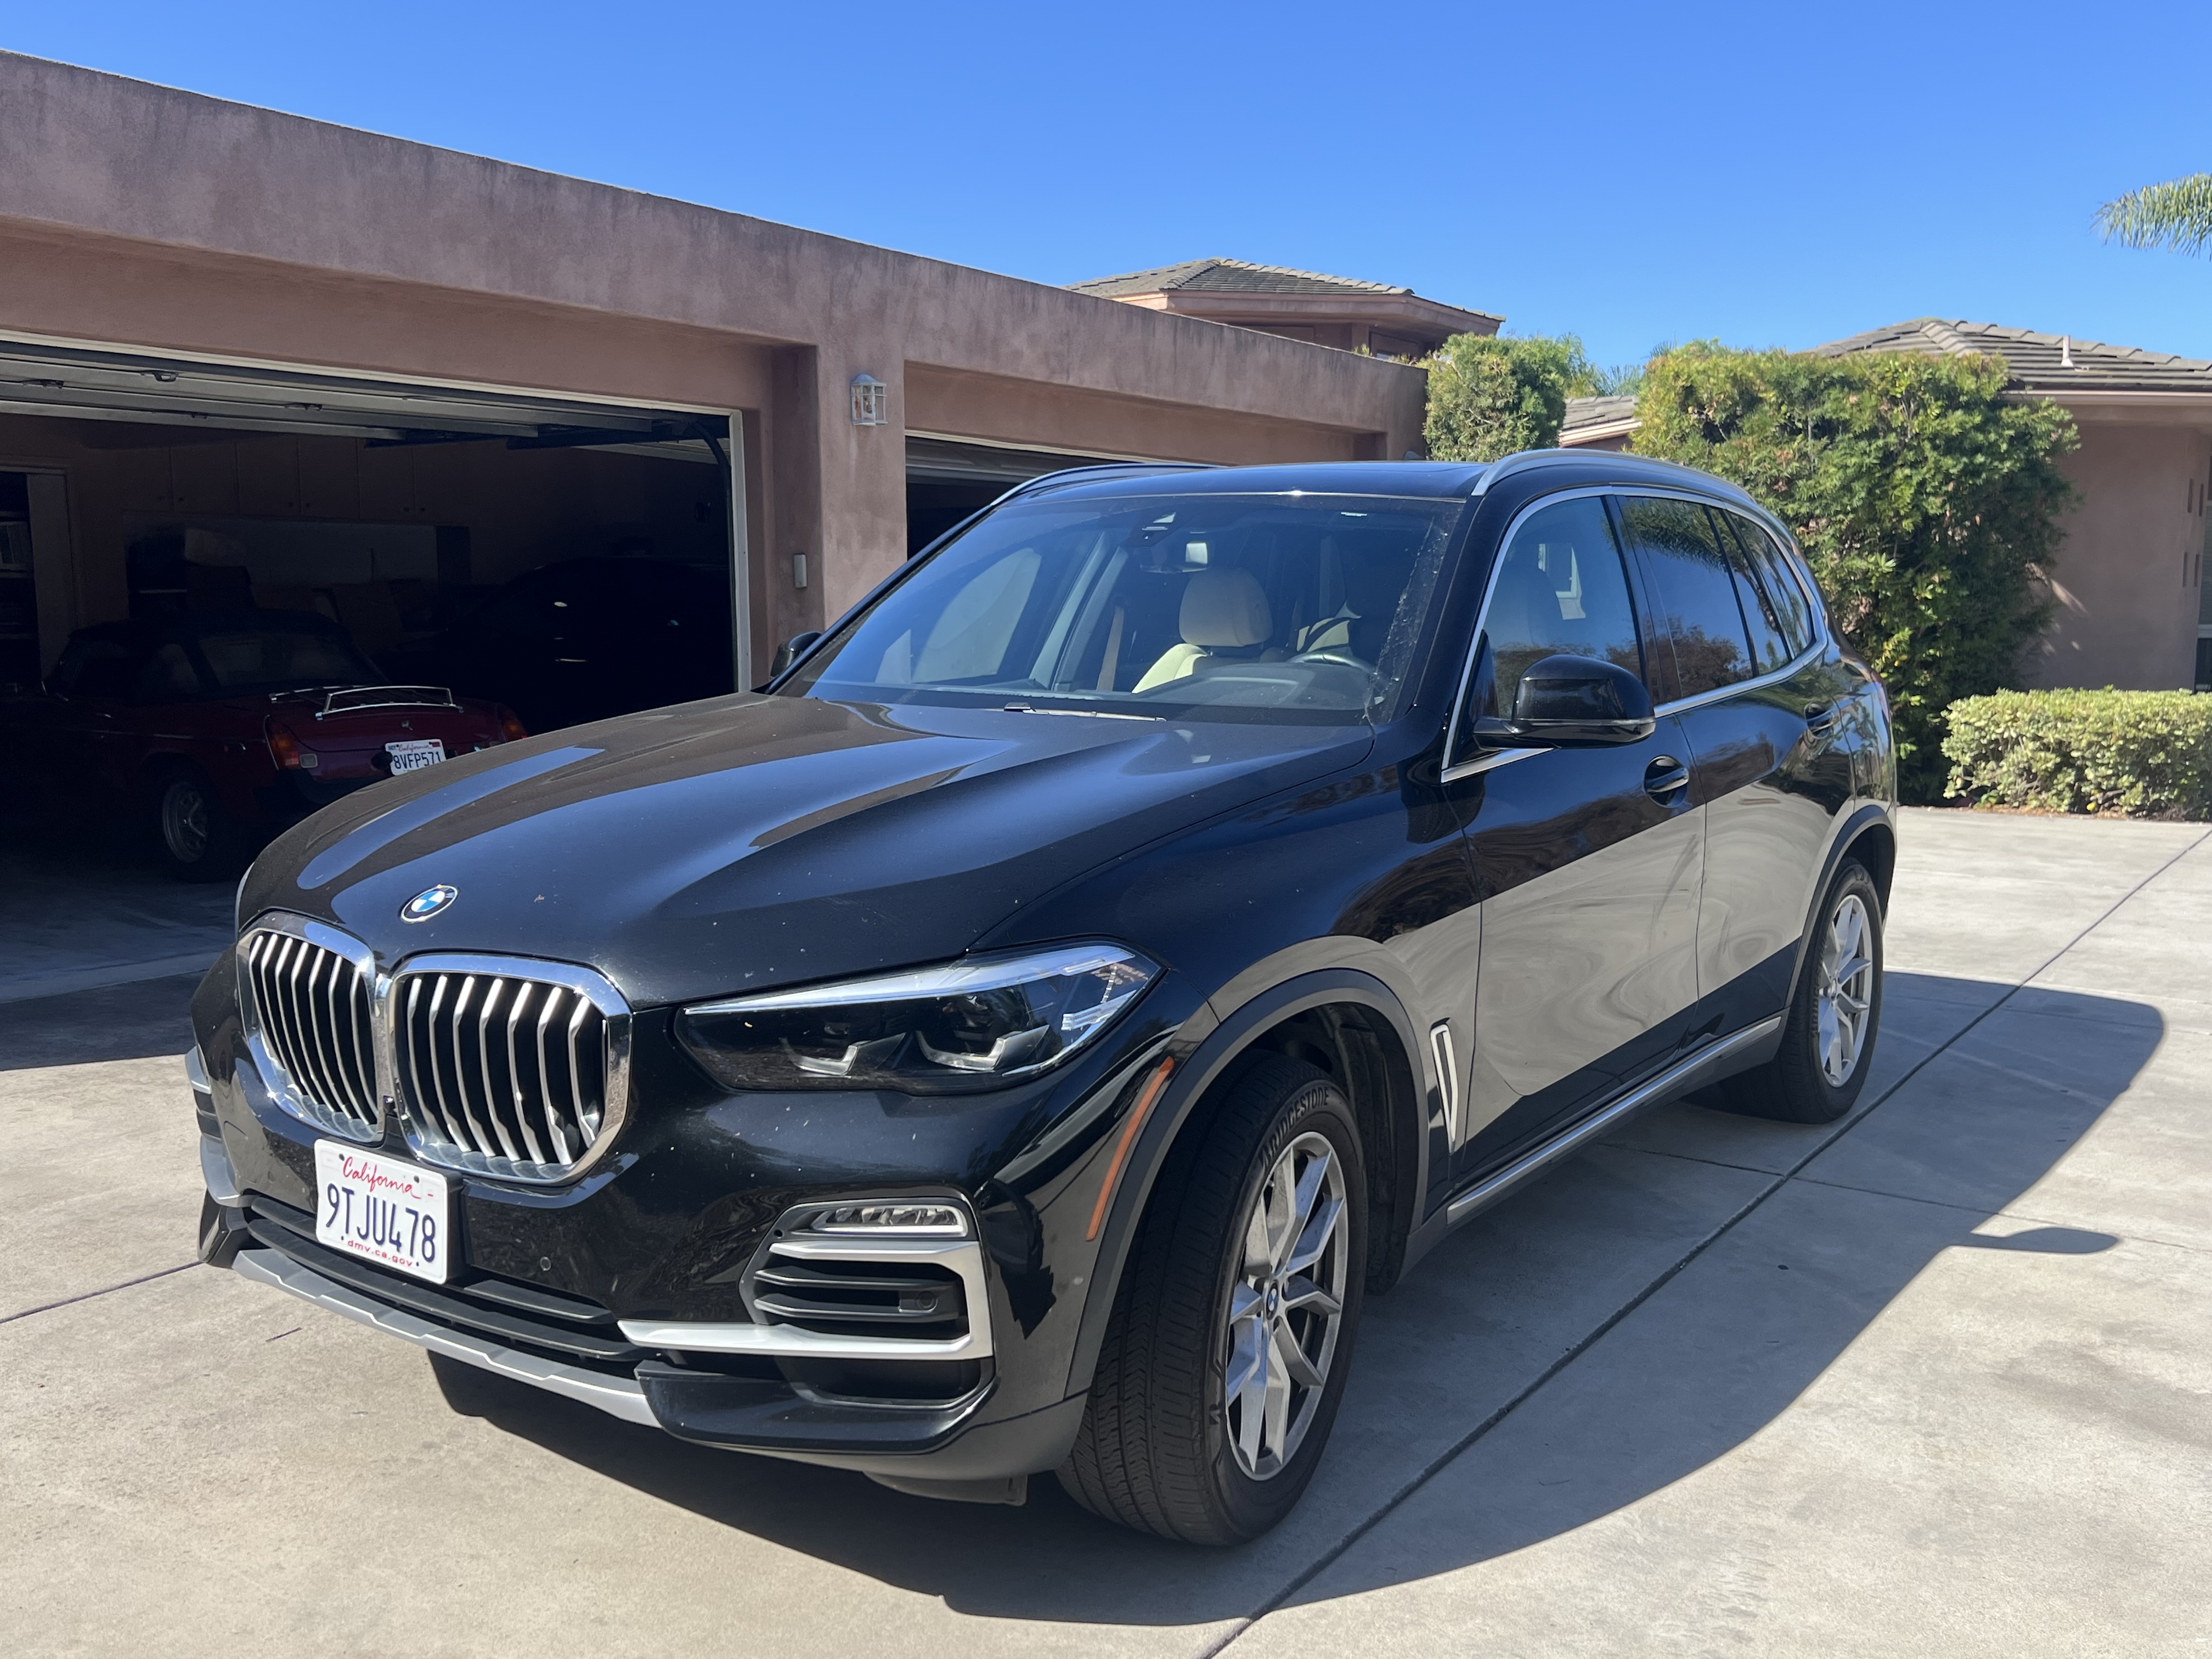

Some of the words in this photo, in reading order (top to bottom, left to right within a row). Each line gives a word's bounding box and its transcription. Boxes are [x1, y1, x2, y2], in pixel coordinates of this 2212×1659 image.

[393, 751, 441, 769] 8VFP571
[398, 744, 432, 752] California
[1258, 1087, 1329, 1169] BRIDGESTONE
[343, 1156, 421, 1199] California
[326, 1183, 435, 1262] 9TJU478
[348, 1239, 413, 1267] dmv.ca.gov
